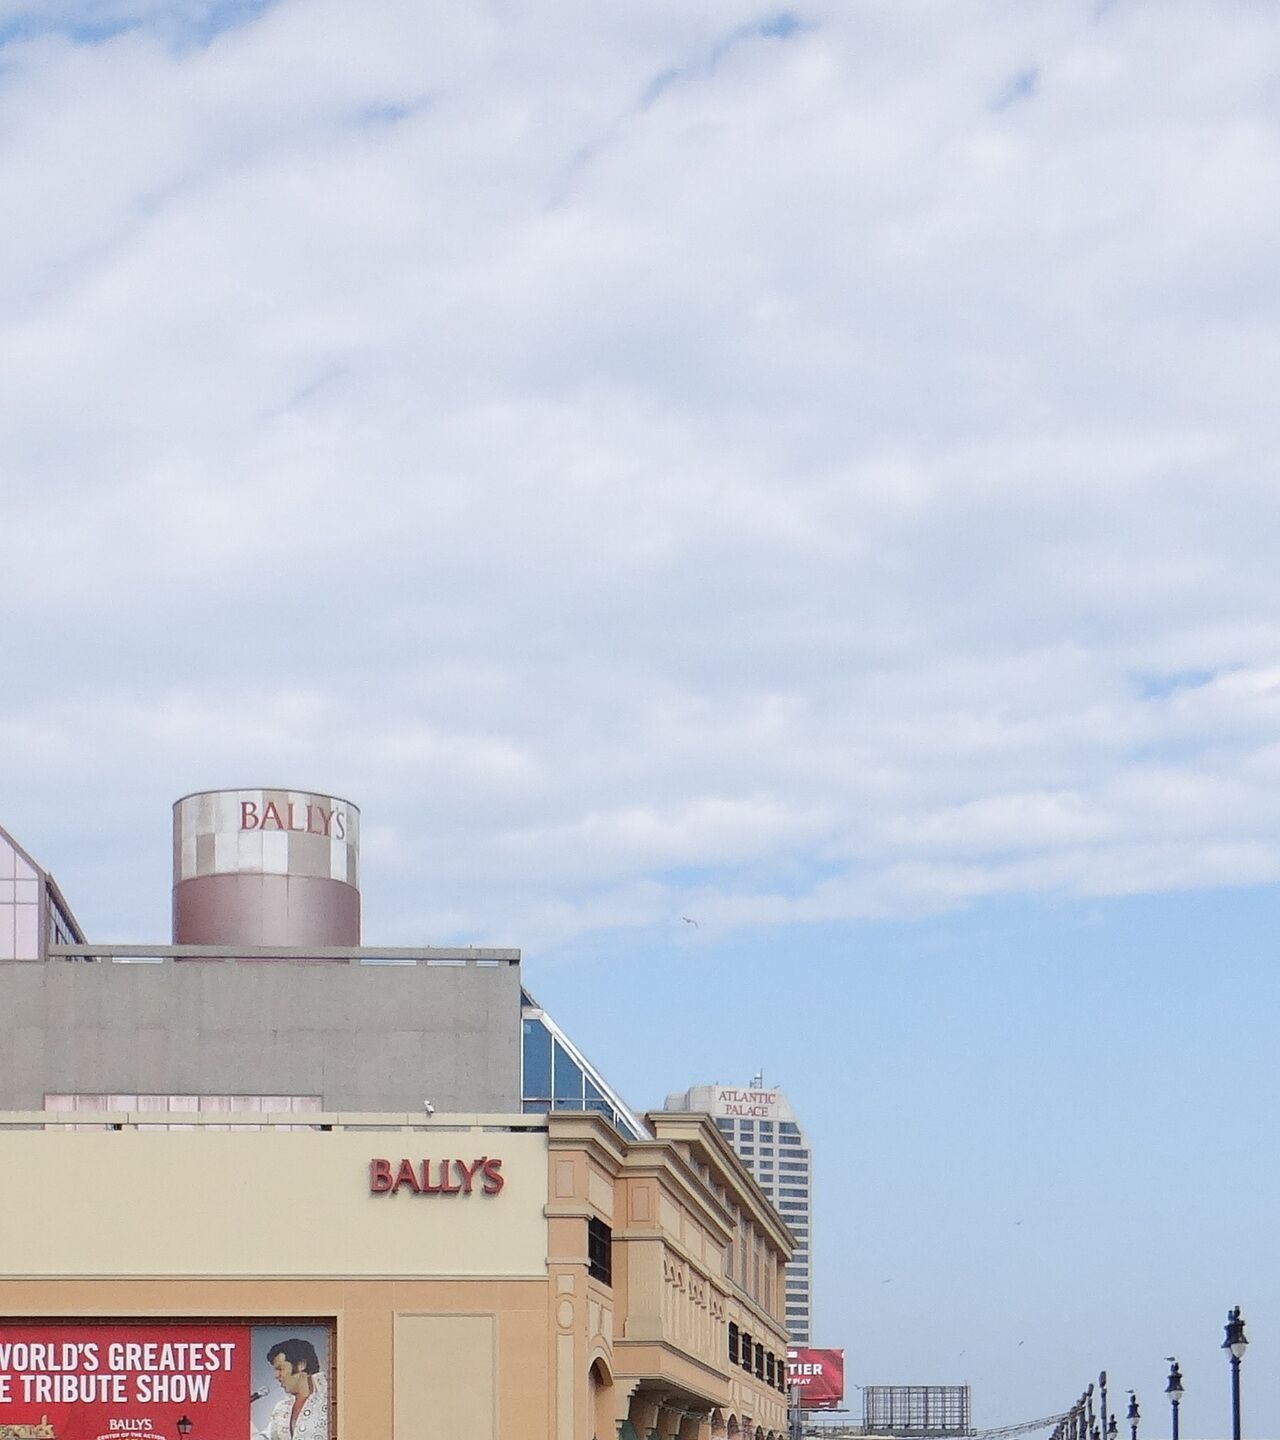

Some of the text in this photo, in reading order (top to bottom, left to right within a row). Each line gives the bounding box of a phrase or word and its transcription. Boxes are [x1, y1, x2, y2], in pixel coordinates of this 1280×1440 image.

[240, 801, 345, 840] BALLY'S
[718, 1090, 776, 1104] ATLANTIC
[725, 1104, 769, 1118] PALACE
[370, 1156, 505, 1194] BALLY'S
[108, 1343, 235, 1371] GREATEST
[20, 1374, 127, 1403] TRIBUTE
[136, 1374, 211, 1403] SHOW
[109, 1418, 152, 1431] BALLY'S
[96, 1433, 120, 1440] CENTER
